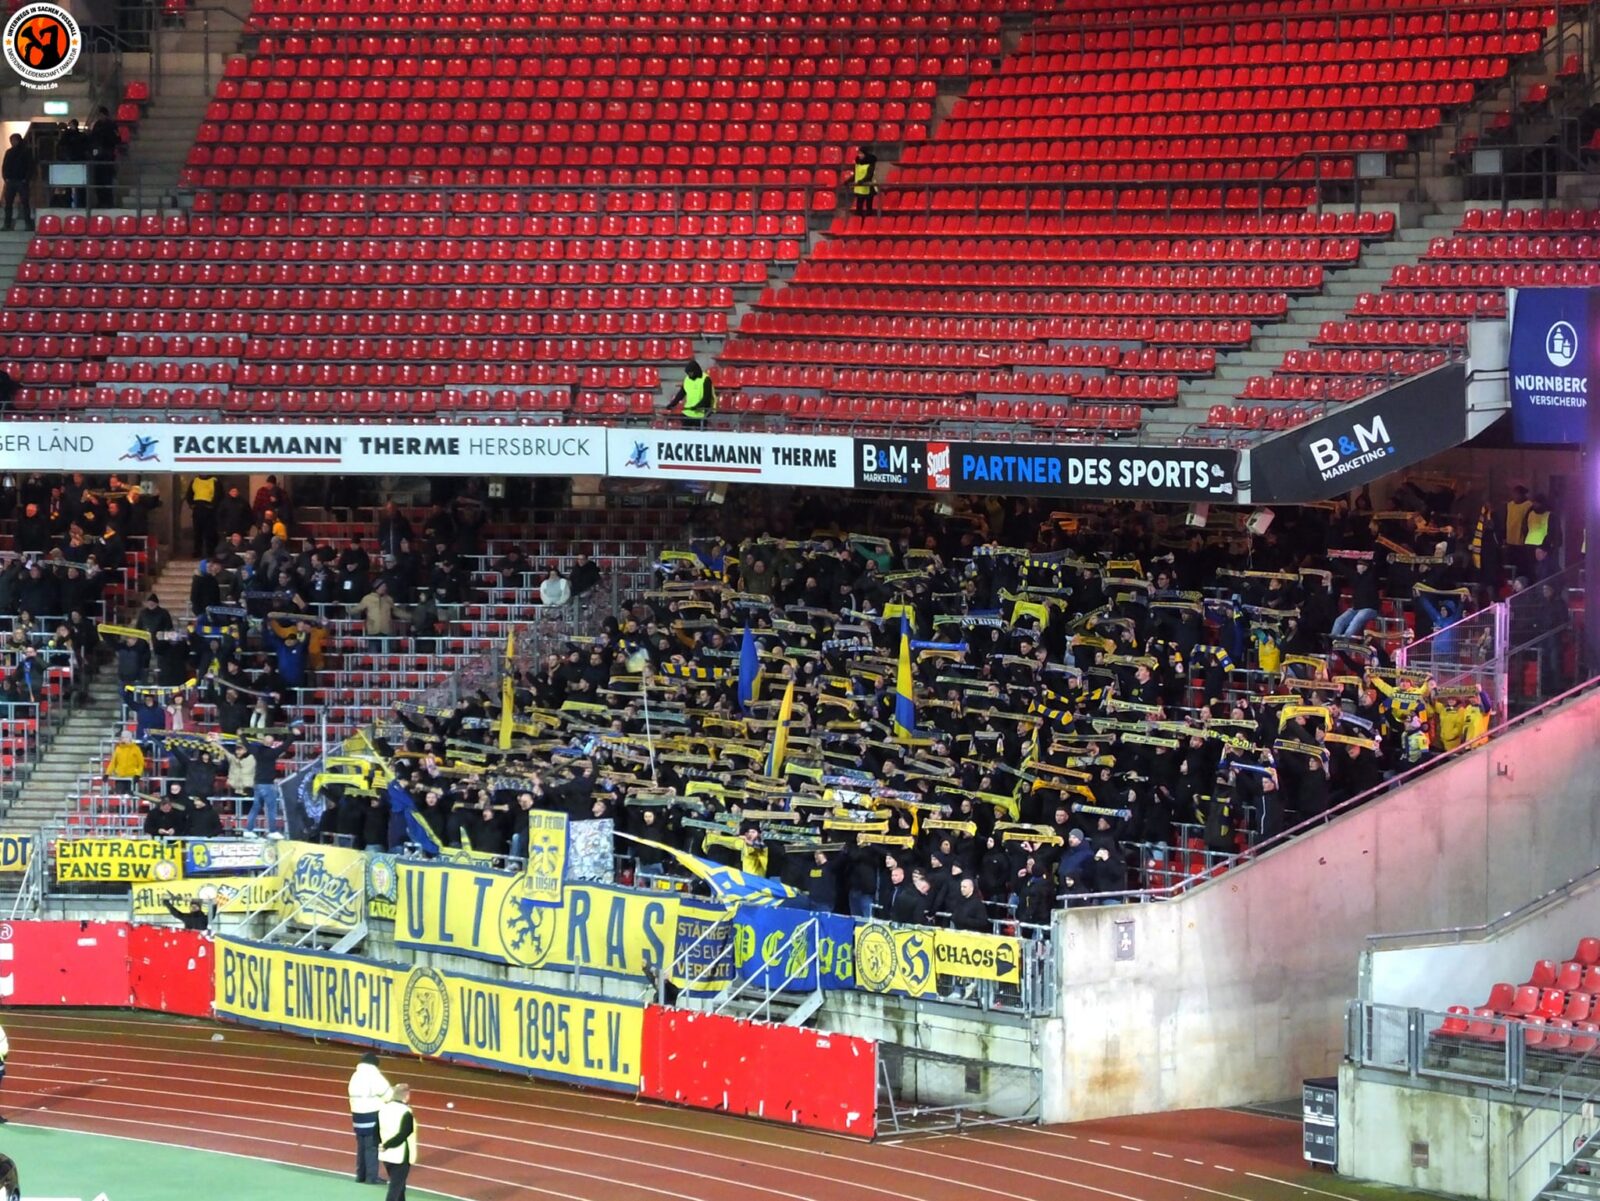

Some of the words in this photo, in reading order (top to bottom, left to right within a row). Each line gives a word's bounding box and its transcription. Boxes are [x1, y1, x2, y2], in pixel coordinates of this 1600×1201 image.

[173, 436, 342, 455] FACKELMANN
[359, 437, 459, 456] THERME
[469, 438, 590, 456] HERSBRUCK
[657, 441, 762, 465] FACKELMANN
[772, 446, 838, 468] THERME
[1309, 415, 1391, 471] B&M
[862, 444, 908, 474] B&M
[962, 454, 1062, 485] PARTNER
[1068, 456, 1112, 487] DES
[1118, 459, 1210, 490] SPORTS
[1320, 446, 1387, 482] MARKETING
[863, 473, 902, 484] MARKETING
[0, 837, 31, 866] DT
[59, 841, 180, 859] EINTRACHT
[59, 861, 112, 878] FANS
[117, 862, 152, 879] BW
[936, 942, 994, 968] CHAOS
[224, 949, 271, 1013] BTSV
[284, 960, 394, 1034] EINTRACHT
[460, 986, 501, 1052] VON
[514, 998, 571, 1065] 1895
[584, 1008, 630, 1075] E.V.
